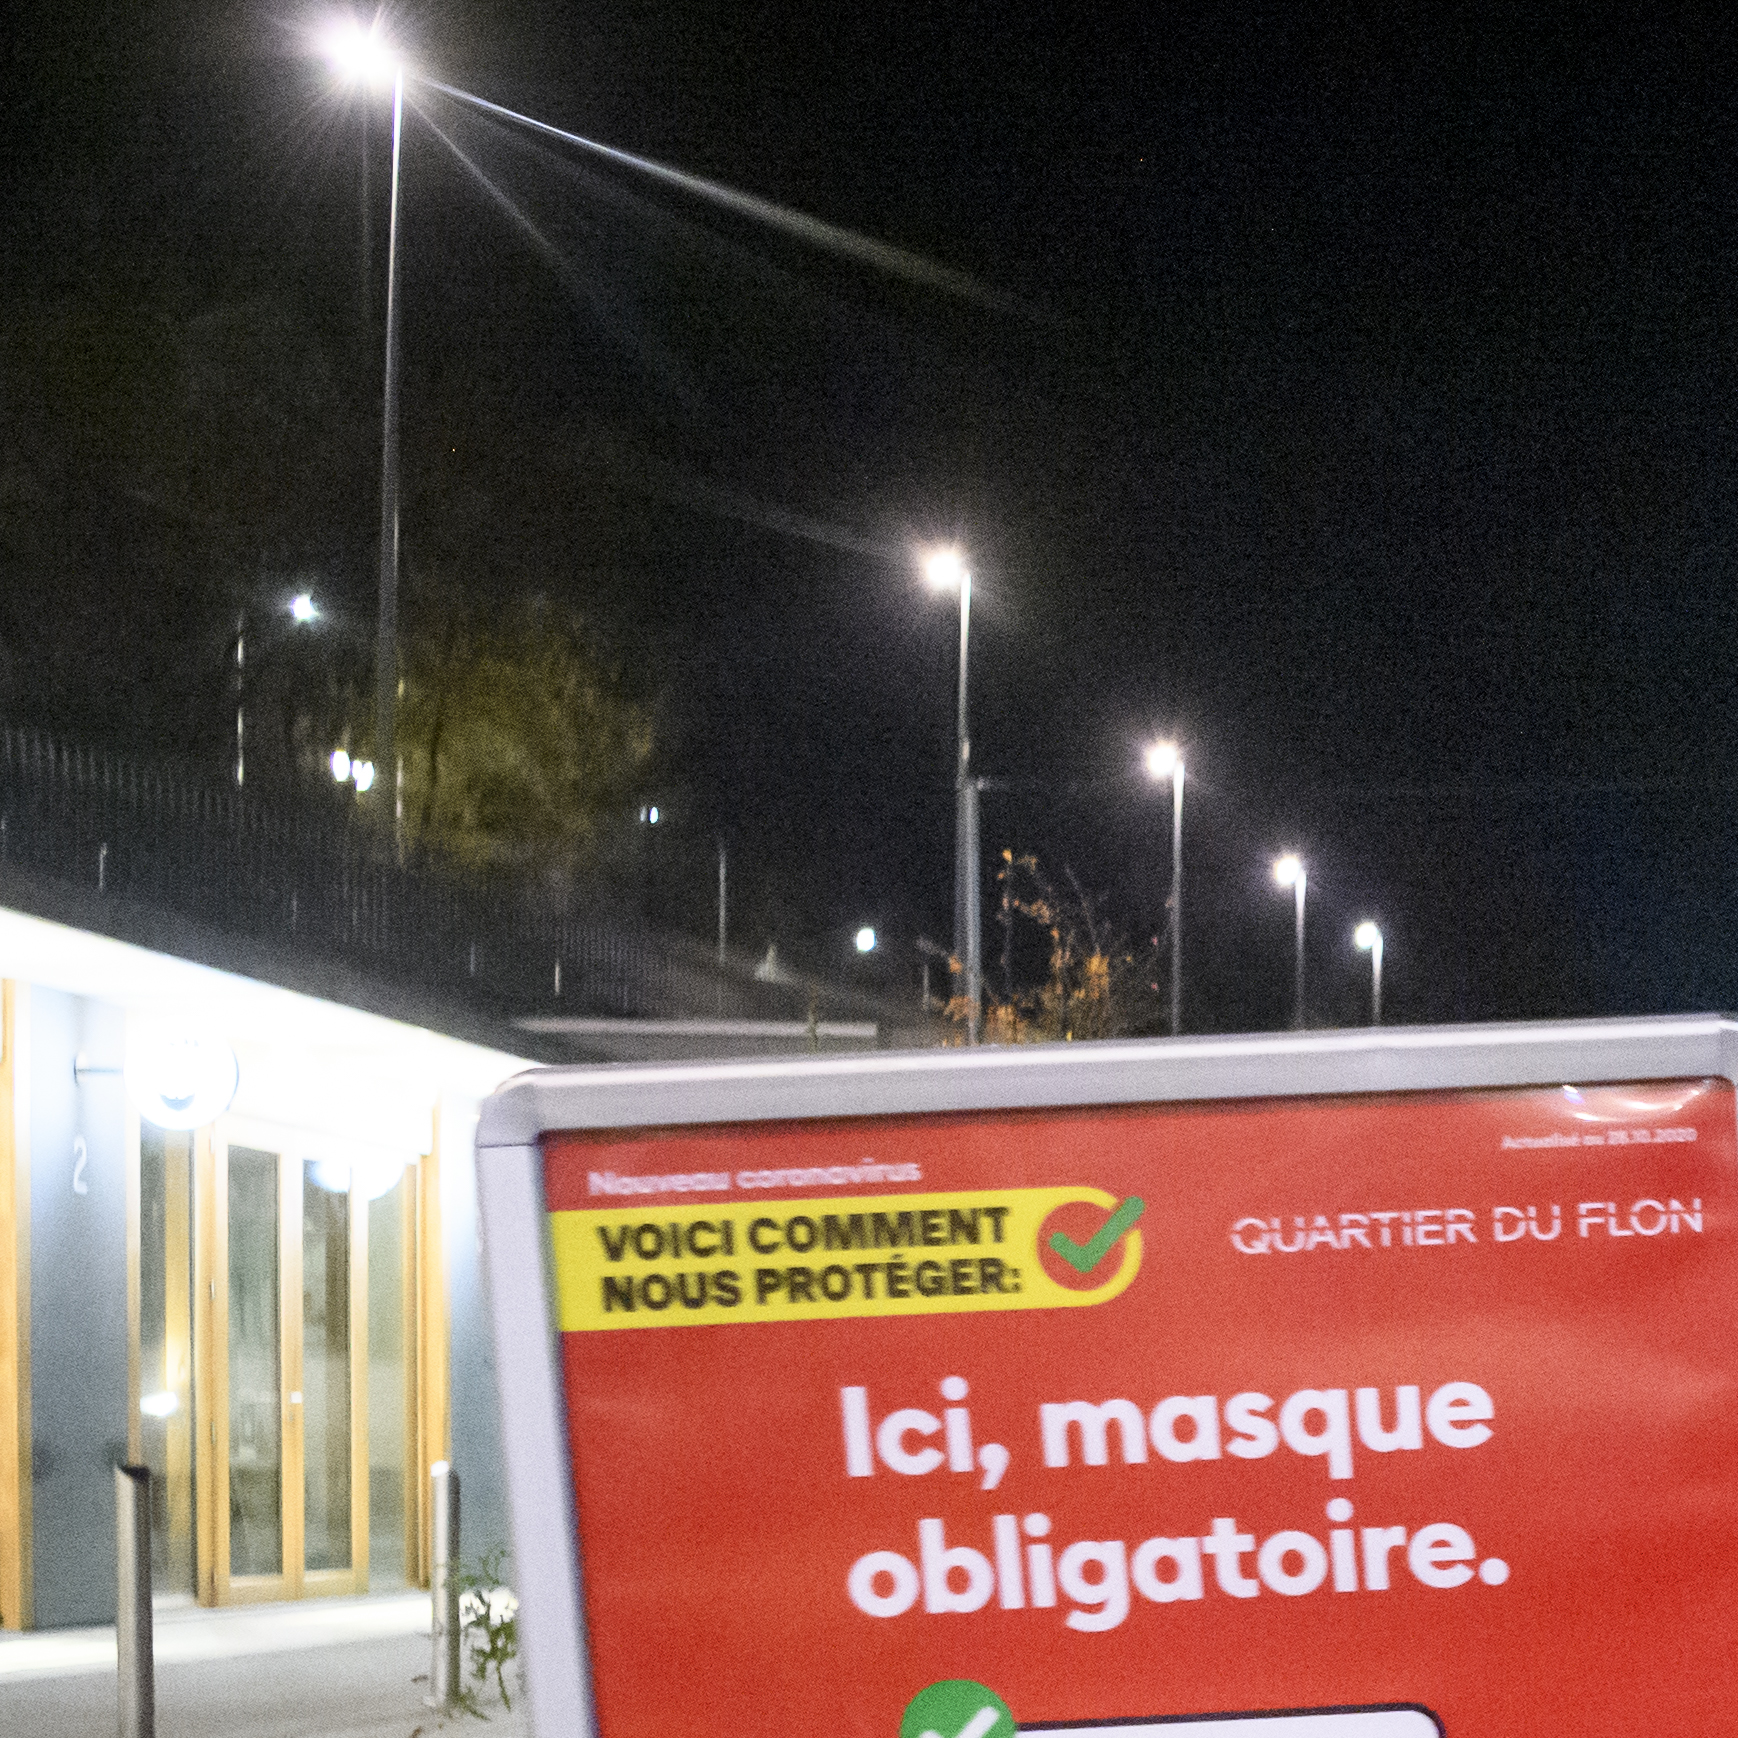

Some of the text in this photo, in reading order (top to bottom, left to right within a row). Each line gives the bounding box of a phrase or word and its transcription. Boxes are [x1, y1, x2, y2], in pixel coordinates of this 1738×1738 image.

[73, 1135, 88, 1194] 2
[588, 1157, 922, 1196] Nouveau coronavirus
[596, 1207, 1011, 1263] VOICI COMMENT
[1230, 1197, 1703, 1255] QUARTIER DU FLON
[600, 1253, 1024, 1313] NOUS PROTÉGER:
[840, 1376, 1495, 1490] Ici, masque
[848, 1498, 1510, 1632] obligatoire.
